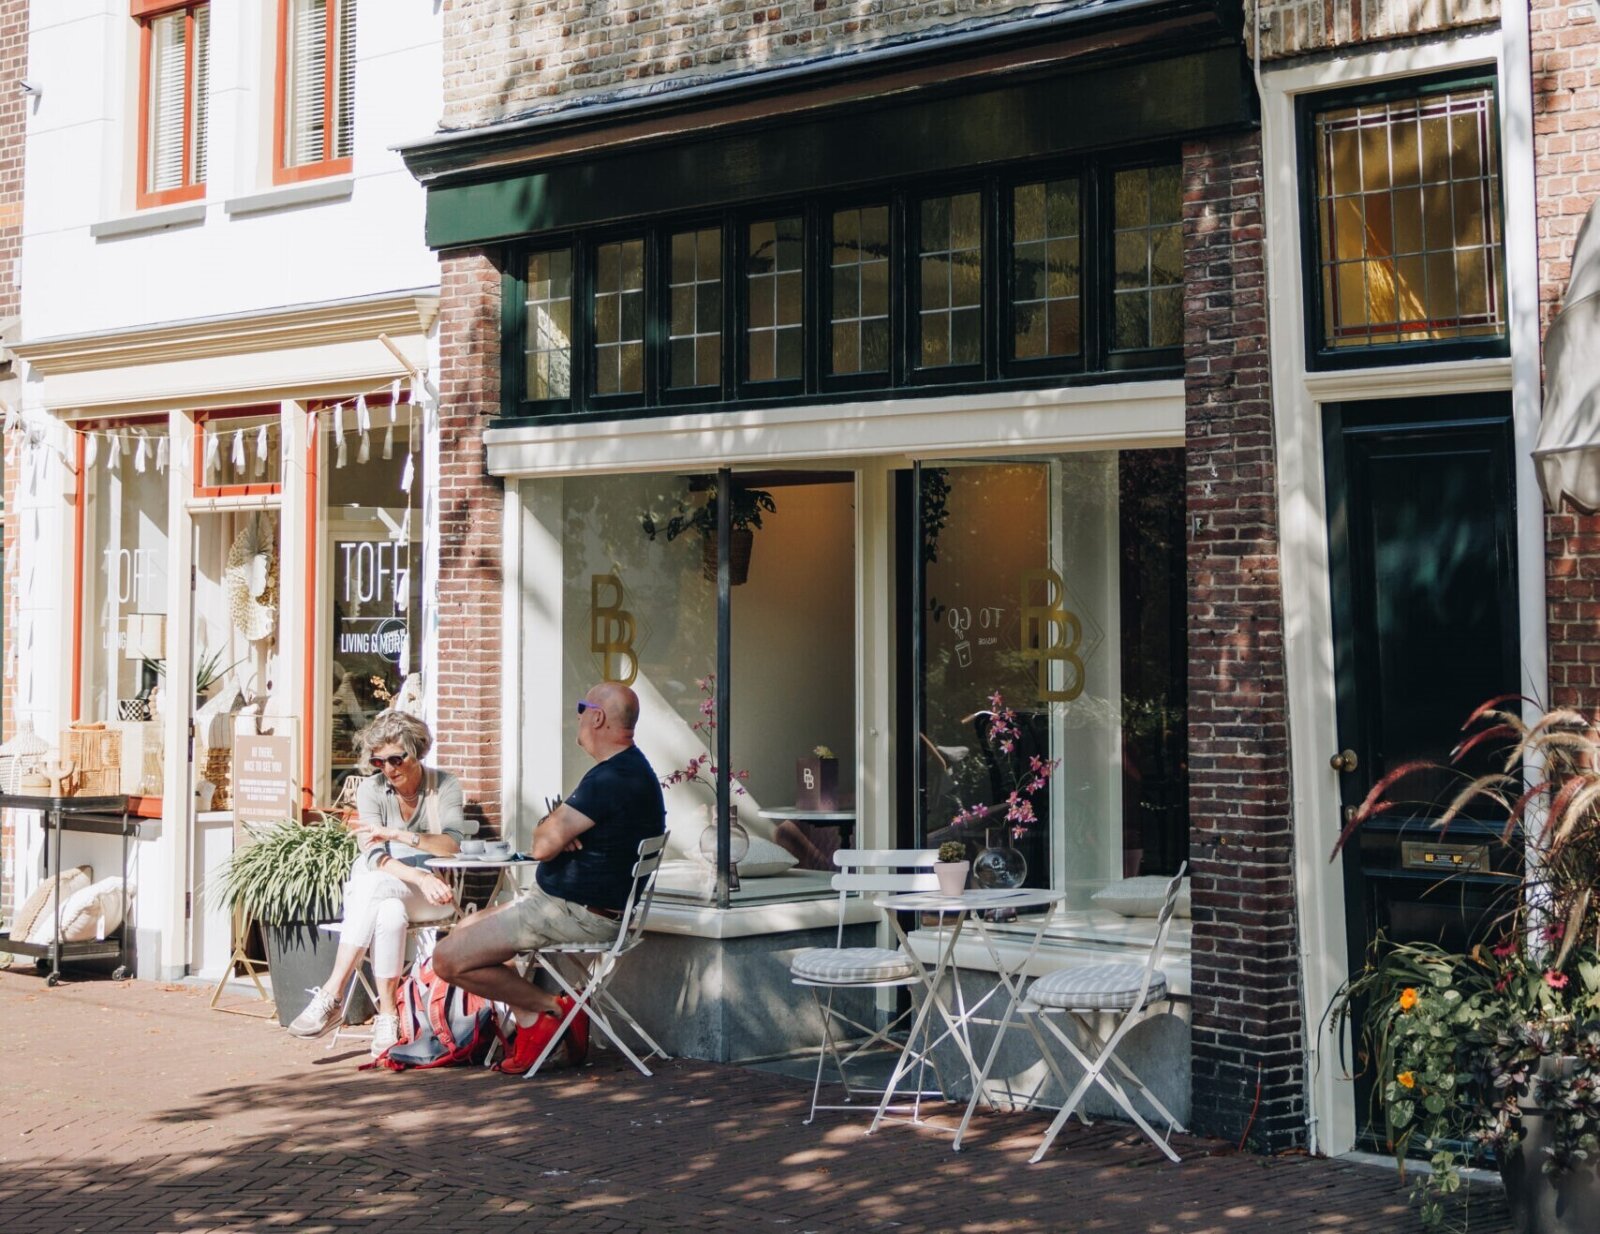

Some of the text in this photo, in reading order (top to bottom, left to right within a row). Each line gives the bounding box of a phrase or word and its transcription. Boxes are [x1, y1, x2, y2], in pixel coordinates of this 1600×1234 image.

[103, 548, 159, 603] TOFF
[341, 542, 408, 602] TOFF
[341, 633, 369, 653] LIVING
[371, 633, 379, 653] &
